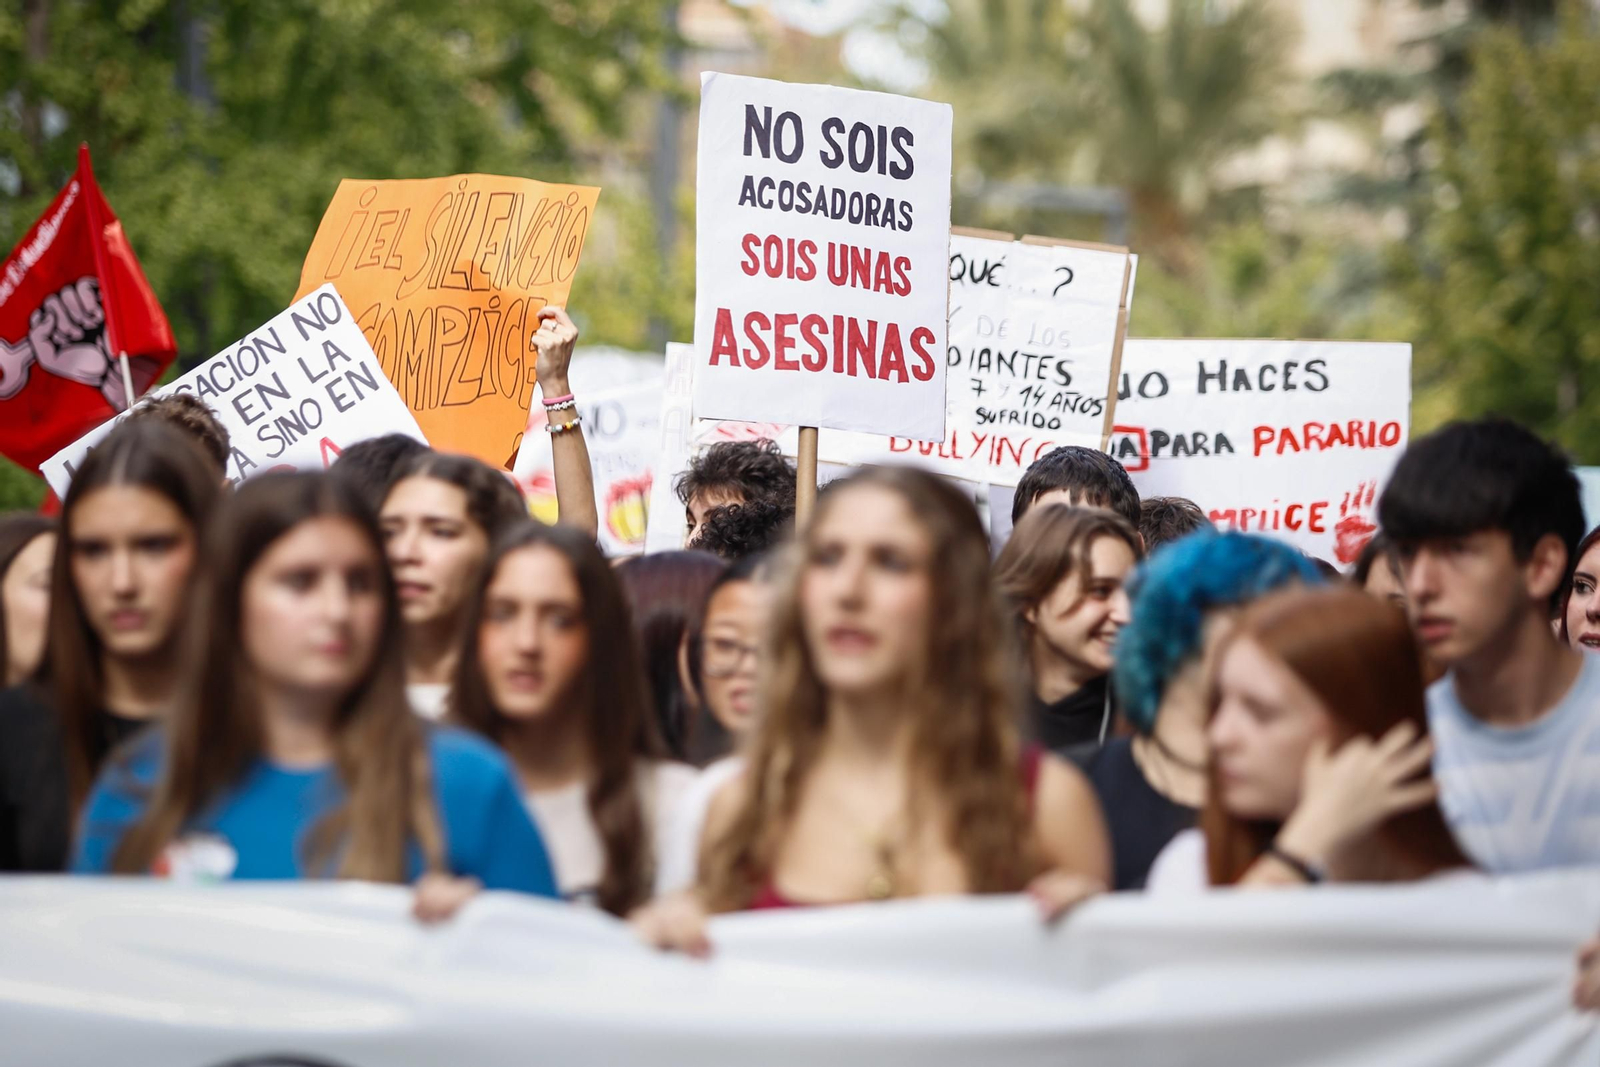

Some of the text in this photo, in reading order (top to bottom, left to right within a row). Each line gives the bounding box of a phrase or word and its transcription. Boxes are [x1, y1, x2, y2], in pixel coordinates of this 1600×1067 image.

[743, 104, 914, 180] NO SOIS
[738, 175, 913, 232] ACOSADORAS
[741, 233, 912, 297] SOIS UNAS
[291, 292, 342, 341] NO
[977, 314, 1072, 348] DE LOS
[708, 307, 936, 383] ASESINAS
[231, 339, 352, 427] EN LA
[971, 378, 987, 397] 7
[1020, 384, 1046, 408] 14
[1047, 391, 1107, 417] AÑOS
[1198, 359, 1329, 394] HACES
[257, 397, 323, 458] SINO
[323, 360, 380, 413] EN
[976, 407, 1062, 430] SUFRIDO
[1150, 429, 1235, 458] PARA
